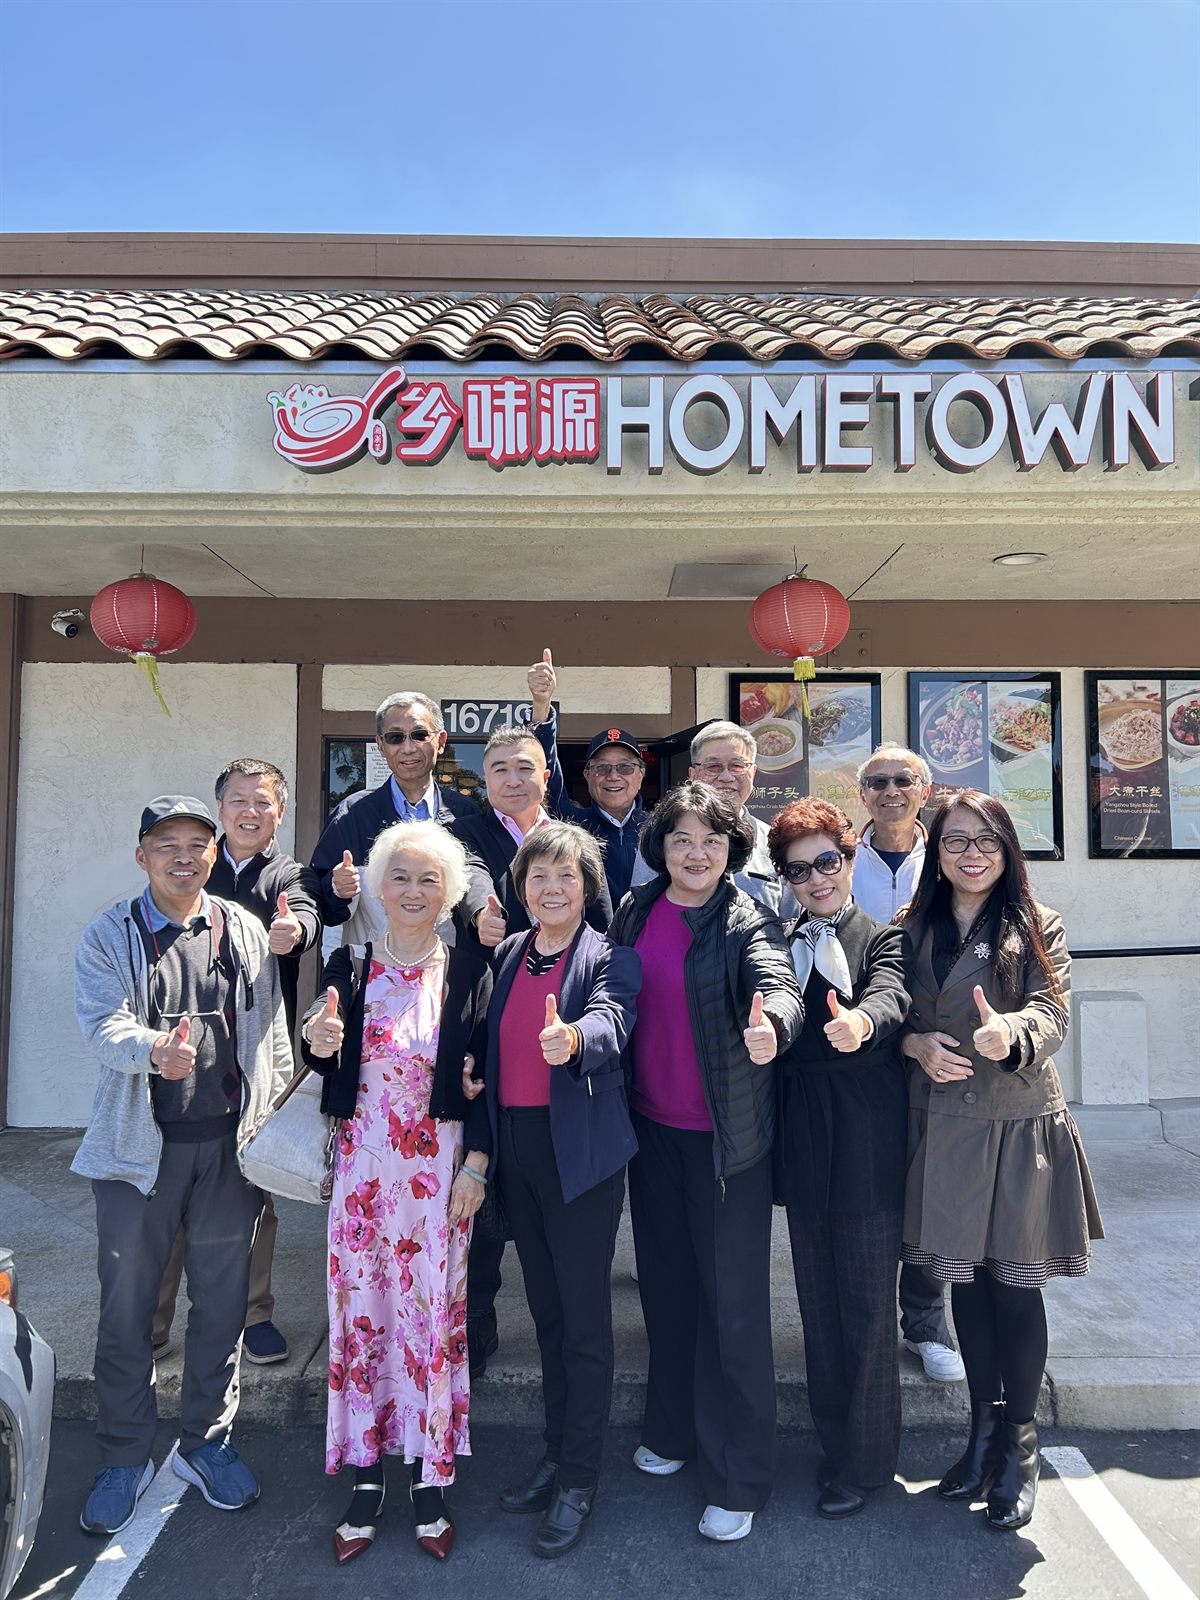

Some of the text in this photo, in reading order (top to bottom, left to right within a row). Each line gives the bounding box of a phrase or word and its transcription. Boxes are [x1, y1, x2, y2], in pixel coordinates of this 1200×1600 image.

[606, 372, 1176, 470] HOMETOWN
[1109, 785, 1163, 798] 大煮干丝
